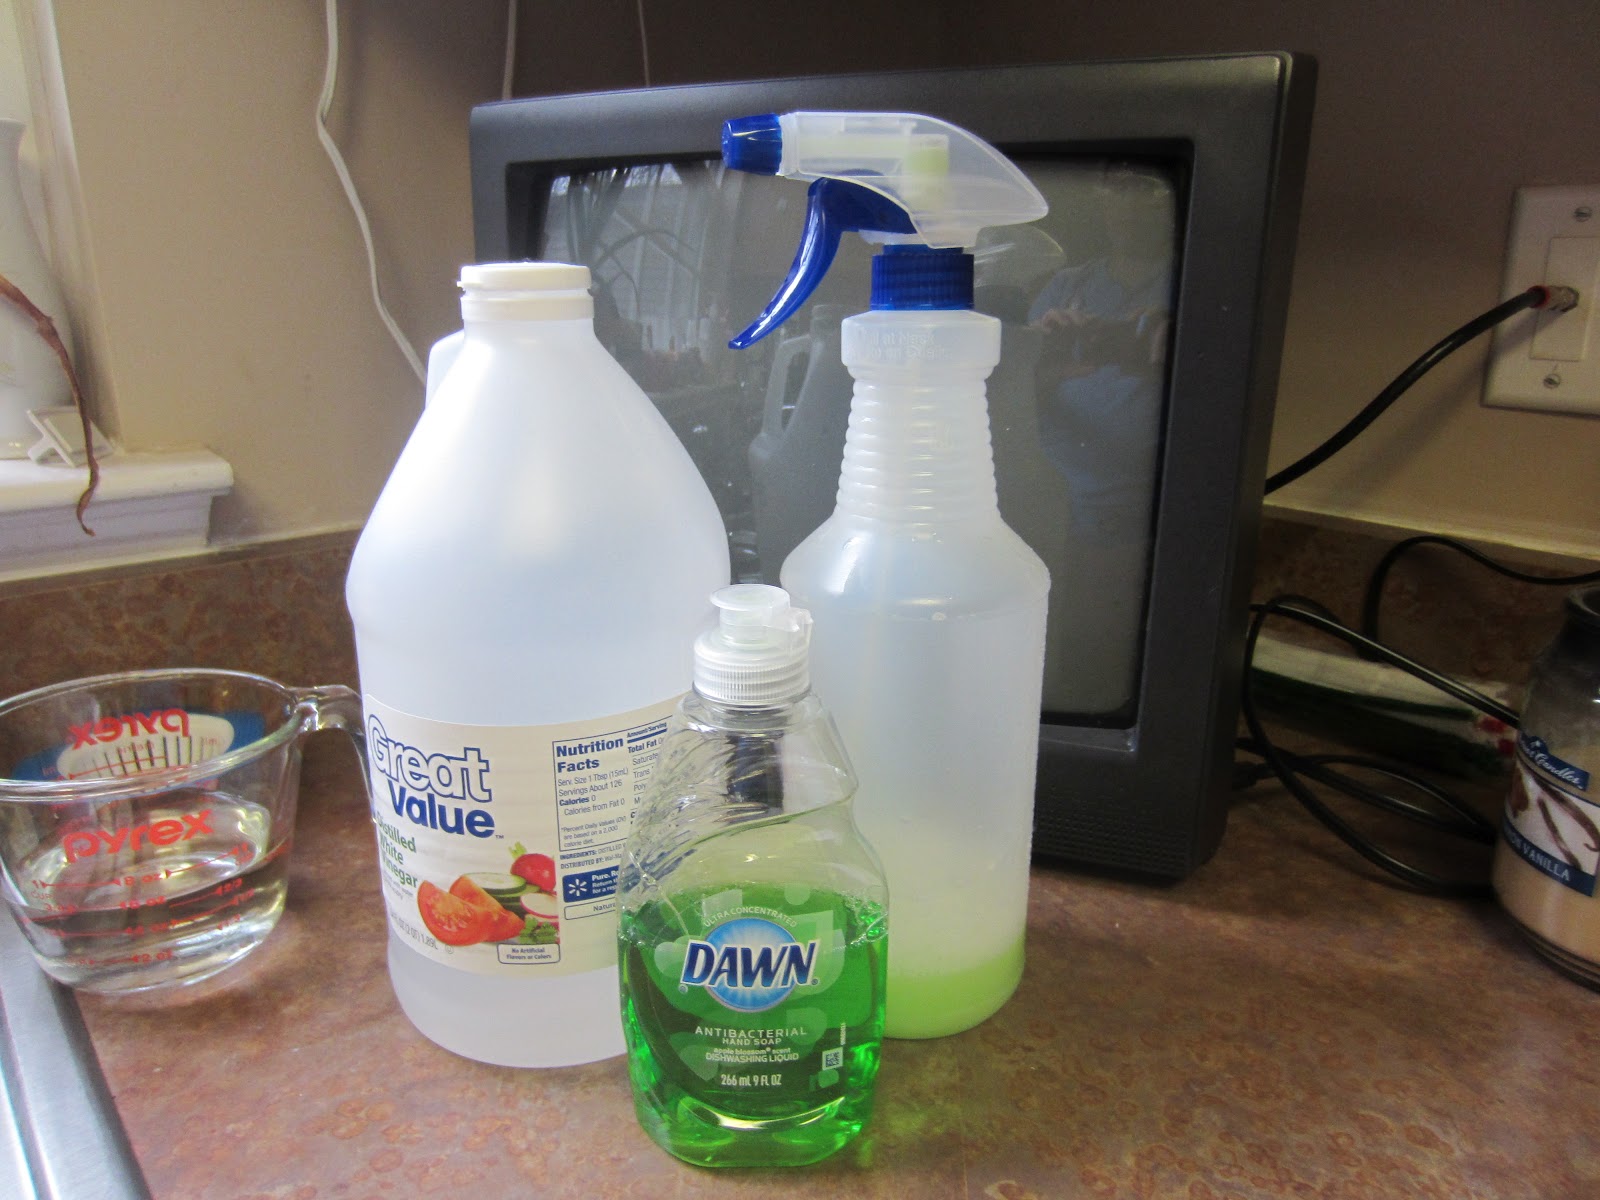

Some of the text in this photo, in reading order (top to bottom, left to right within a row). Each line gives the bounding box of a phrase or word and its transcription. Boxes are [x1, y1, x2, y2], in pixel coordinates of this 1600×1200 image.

[556, 738, 624, 758] Nutrition
[627, 743, 645, 754] Total
[646, 739, 657, 749] Fat
[368, 714, 492, 803] Great
[557, 758, 600, 774] Facts
[574, 776, 587, 784] Size
[594, 773, 608, 781] Tbsp
[633, 768, 650, 779] Trans
[558, 779, 623, 797] Servings About 126
[388, 779, 496, 838] Value
[559, 796, 590, 806] Calories
[564, 806, 591, 816] Calories
[592, 802, 608, 811] from
[609, 799, 620, 808] Fat
[620, 798, 625, 806] 0
[62, 809, 215, 863] pyrex
[1523, 842, 1571, 882] VANILLA
[703, 906, 798, 928] ULTRA CONCENTRATED
[680, 938, 821, 990] DAWN
[695, 1025, 807, 1039] ANTIBACTERIAL
[722, 1037, 782, 1046] HAND SOAP
[705, 1052, 799, 1063] DISHWASHING LIQUID
[713, 1047, 735, 1055] apple
[720, 1073, 738, 1087] 266
[753, 1074, 759, 1086] 9
[760, 1074, 770, 1086] FL
[770, 1073, 782, 1086] OZ
